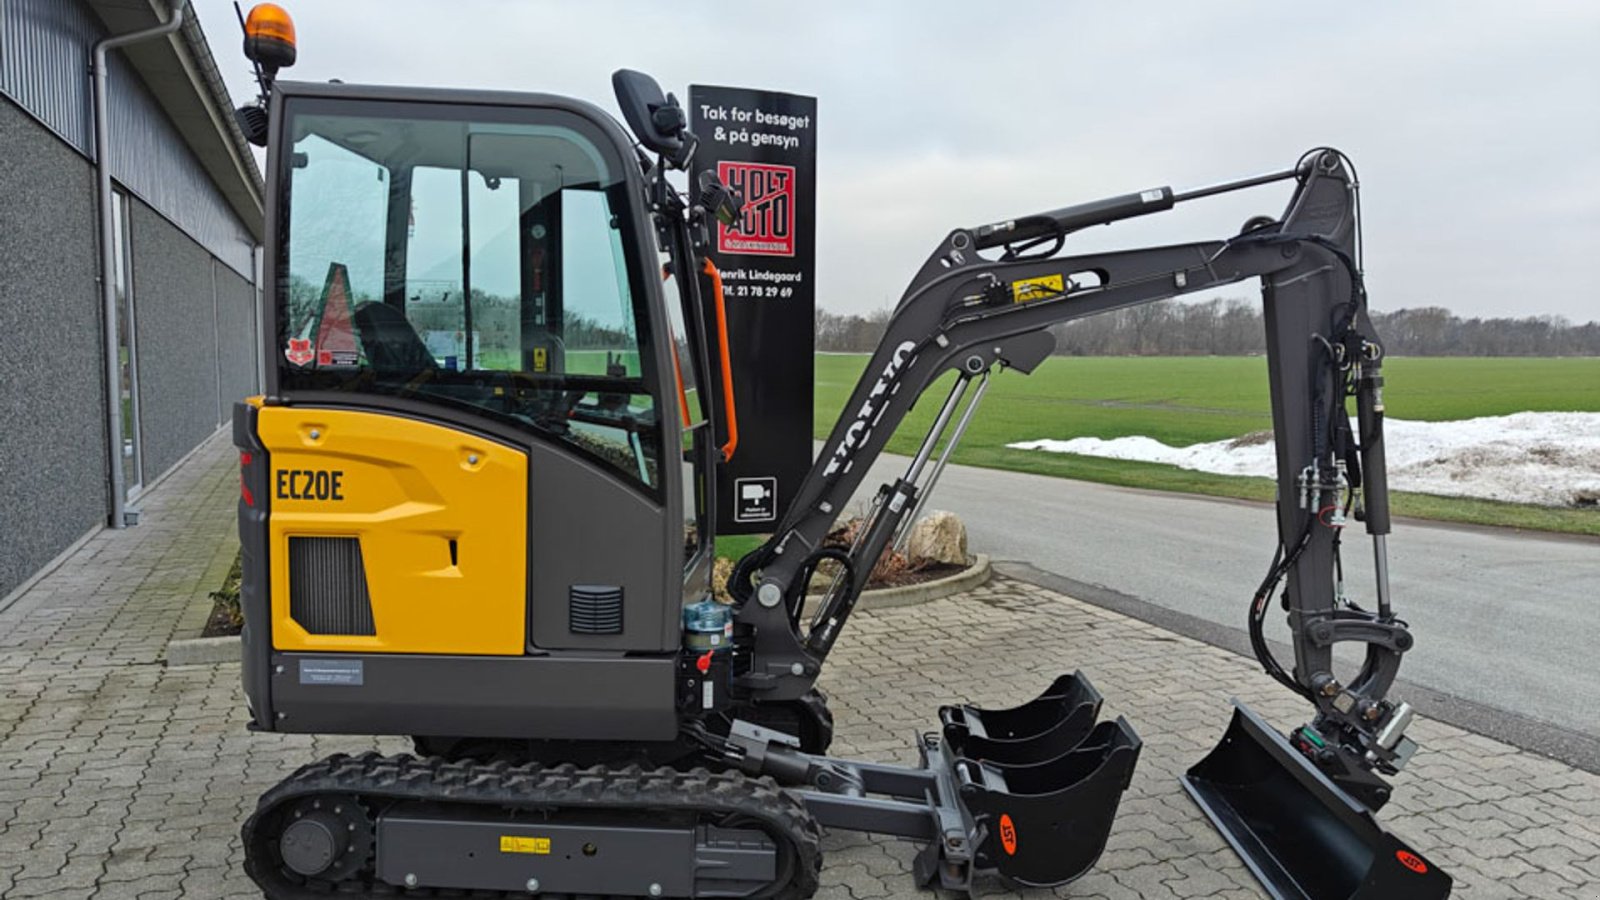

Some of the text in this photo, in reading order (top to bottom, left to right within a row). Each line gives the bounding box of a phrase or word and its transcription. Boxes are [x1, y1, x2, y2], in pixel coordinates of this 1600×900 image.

[700, 104, 810, 130] Tak for besøget
[714, 126, 799, 150] & på gensyn
[729, 167, 788, 206] HOLT
[717, 268, 802, 283] enrik Lindegaard
[737, 285, 748, 297] 21
[750, 285, 763, 297] 78
[765, 286, 778, 298] 29
[780, 287, 793, 298] 69
[822, 340, 917, 477] VOLVO
[276, 469, 344, 500] EC20E
